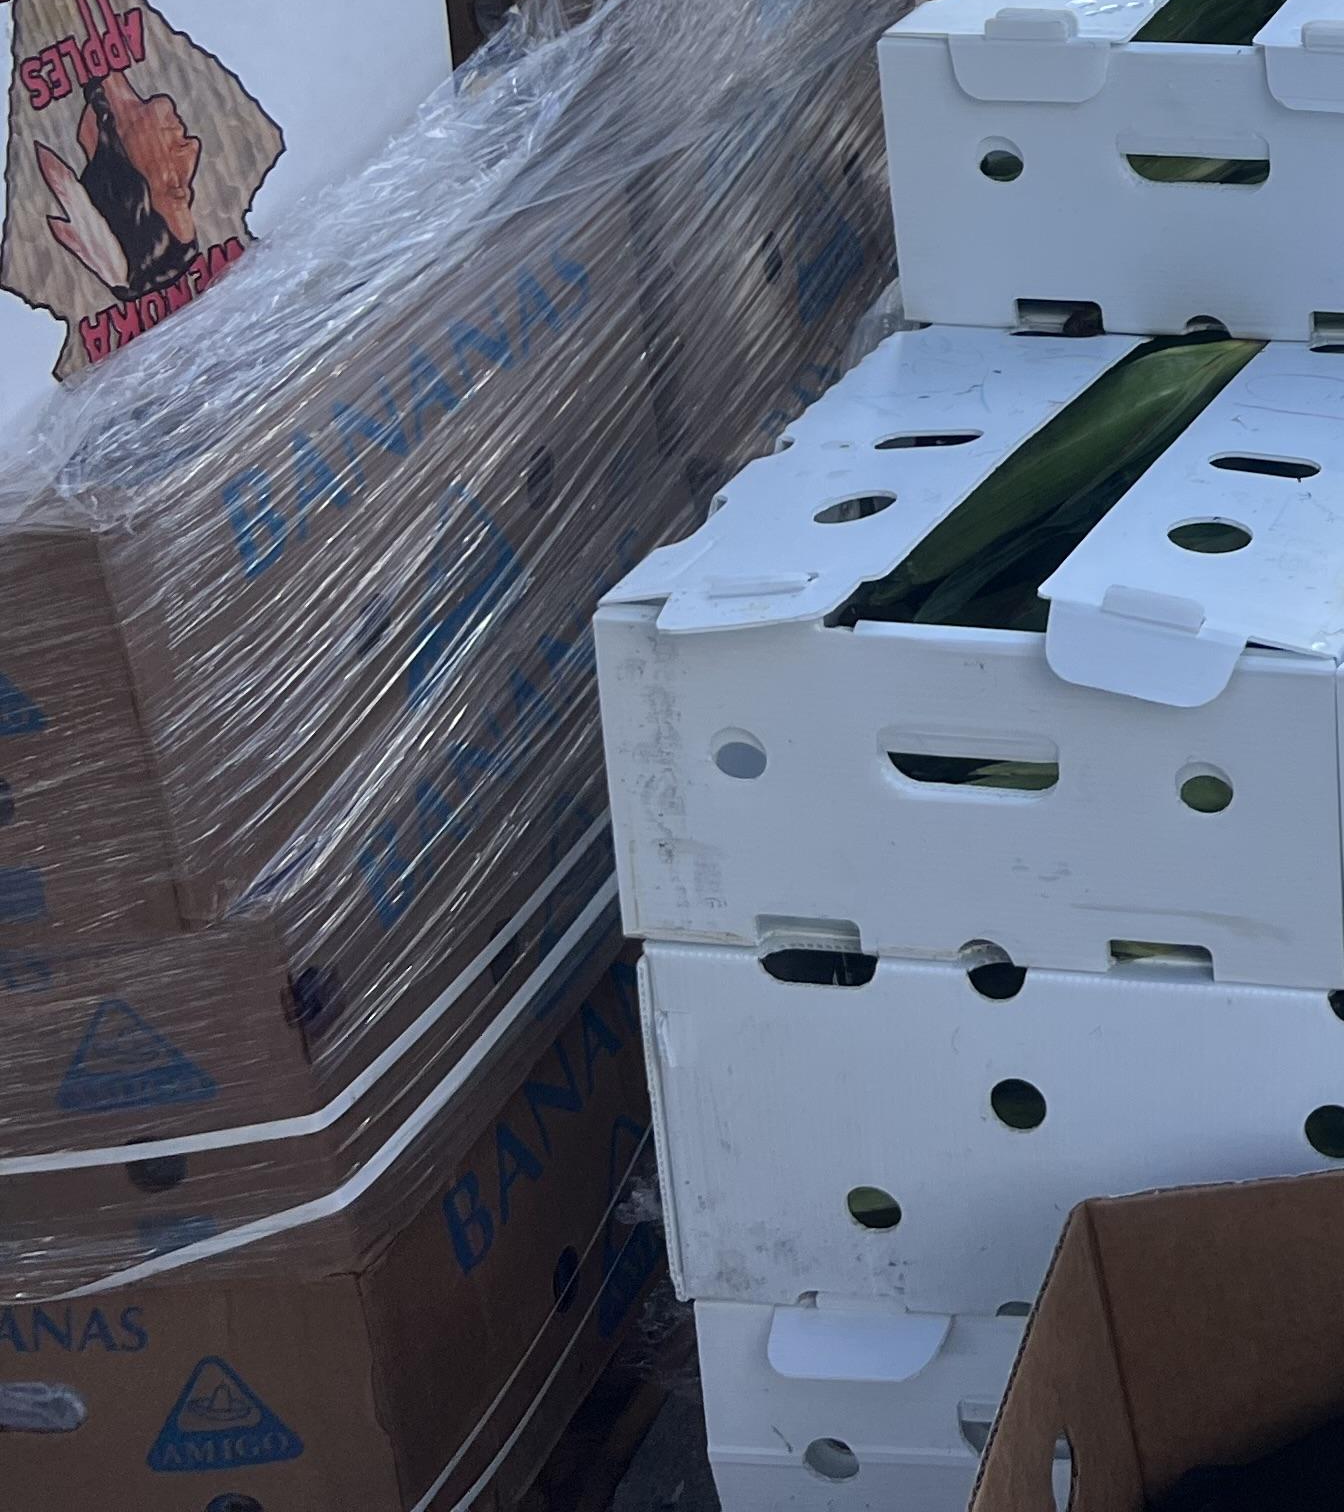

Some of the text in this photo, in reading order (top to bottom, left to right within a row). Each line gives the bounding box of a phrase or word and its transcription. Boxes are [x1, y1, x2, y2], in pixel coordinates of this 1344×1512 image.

[442, 960, 639, 1277] BANAN
[0, 1305, 149, 1353] ANAS
[161, 1431, 291, 1466] AMIGO
